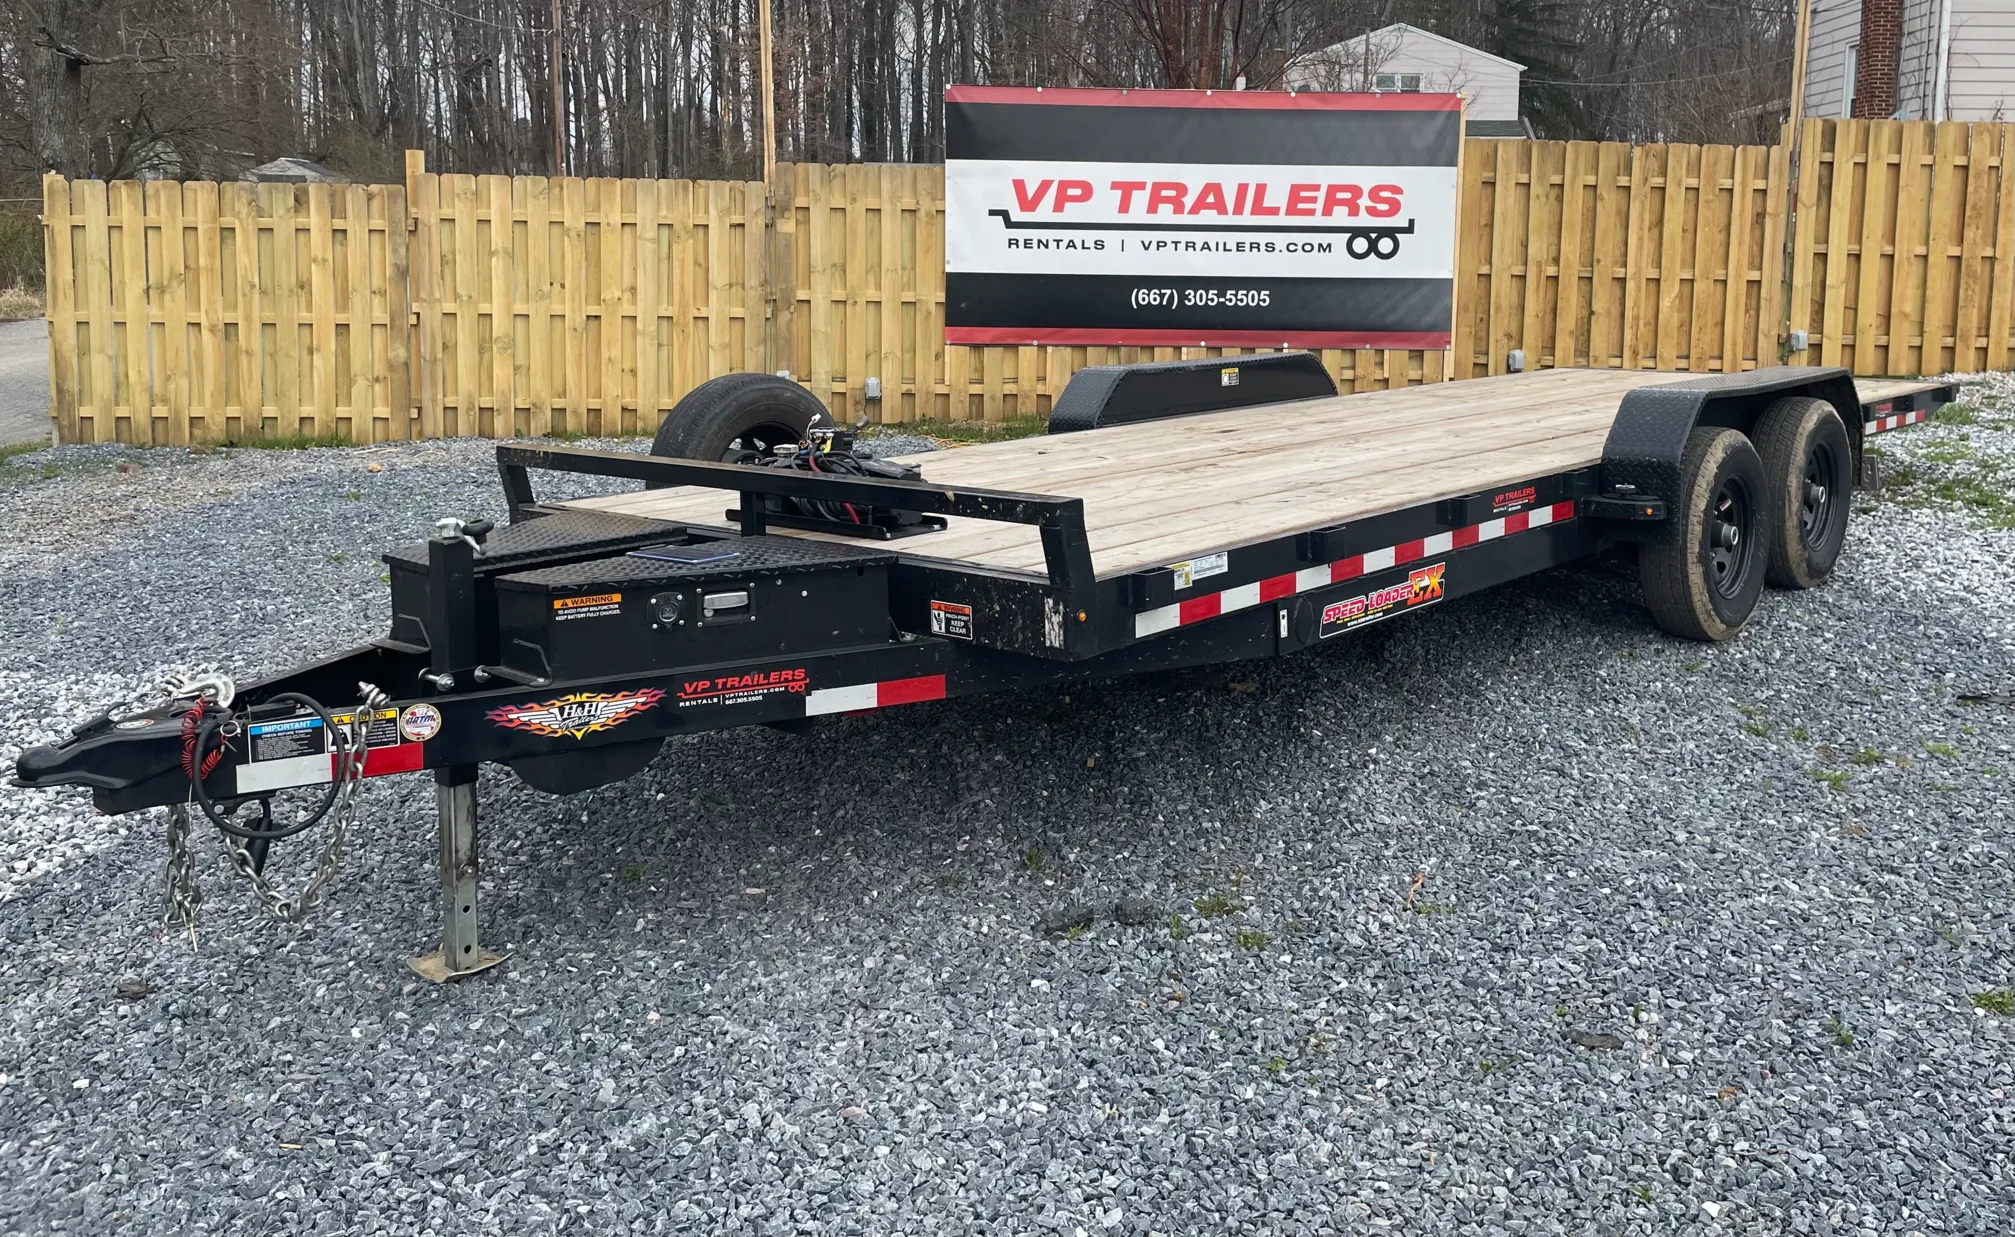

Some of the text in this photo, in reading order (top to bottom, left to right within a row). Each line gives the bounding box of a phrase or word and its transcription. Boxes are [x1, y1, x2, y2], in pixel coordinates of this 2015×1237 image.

[1012, 179, 1404, 218] VP TRAILERS
[1008, 238, 1105, 250] RENTALS
[1141, 240, 1332, 254] VPTRAILERS.COM
[1131, 289, 1270, 309] (667) 305-5505
[1495, 487, 1535, 503] VP TRAILERS
[1407, 562, 1445, 606] EX
[570, 596, 613, 606] WARNING
[1323, 598, 1365, 624] SPEED
[1368, 584, 1414, 609] LOADER
[950, 626, 966, 634] CLEAR
[684, 668, 806, 693] VP TRAILERS
[679, 687, 785, 707] RENTALS VPTRAILERS.COM
[262, 721, 312, 732] IMPORTANT
